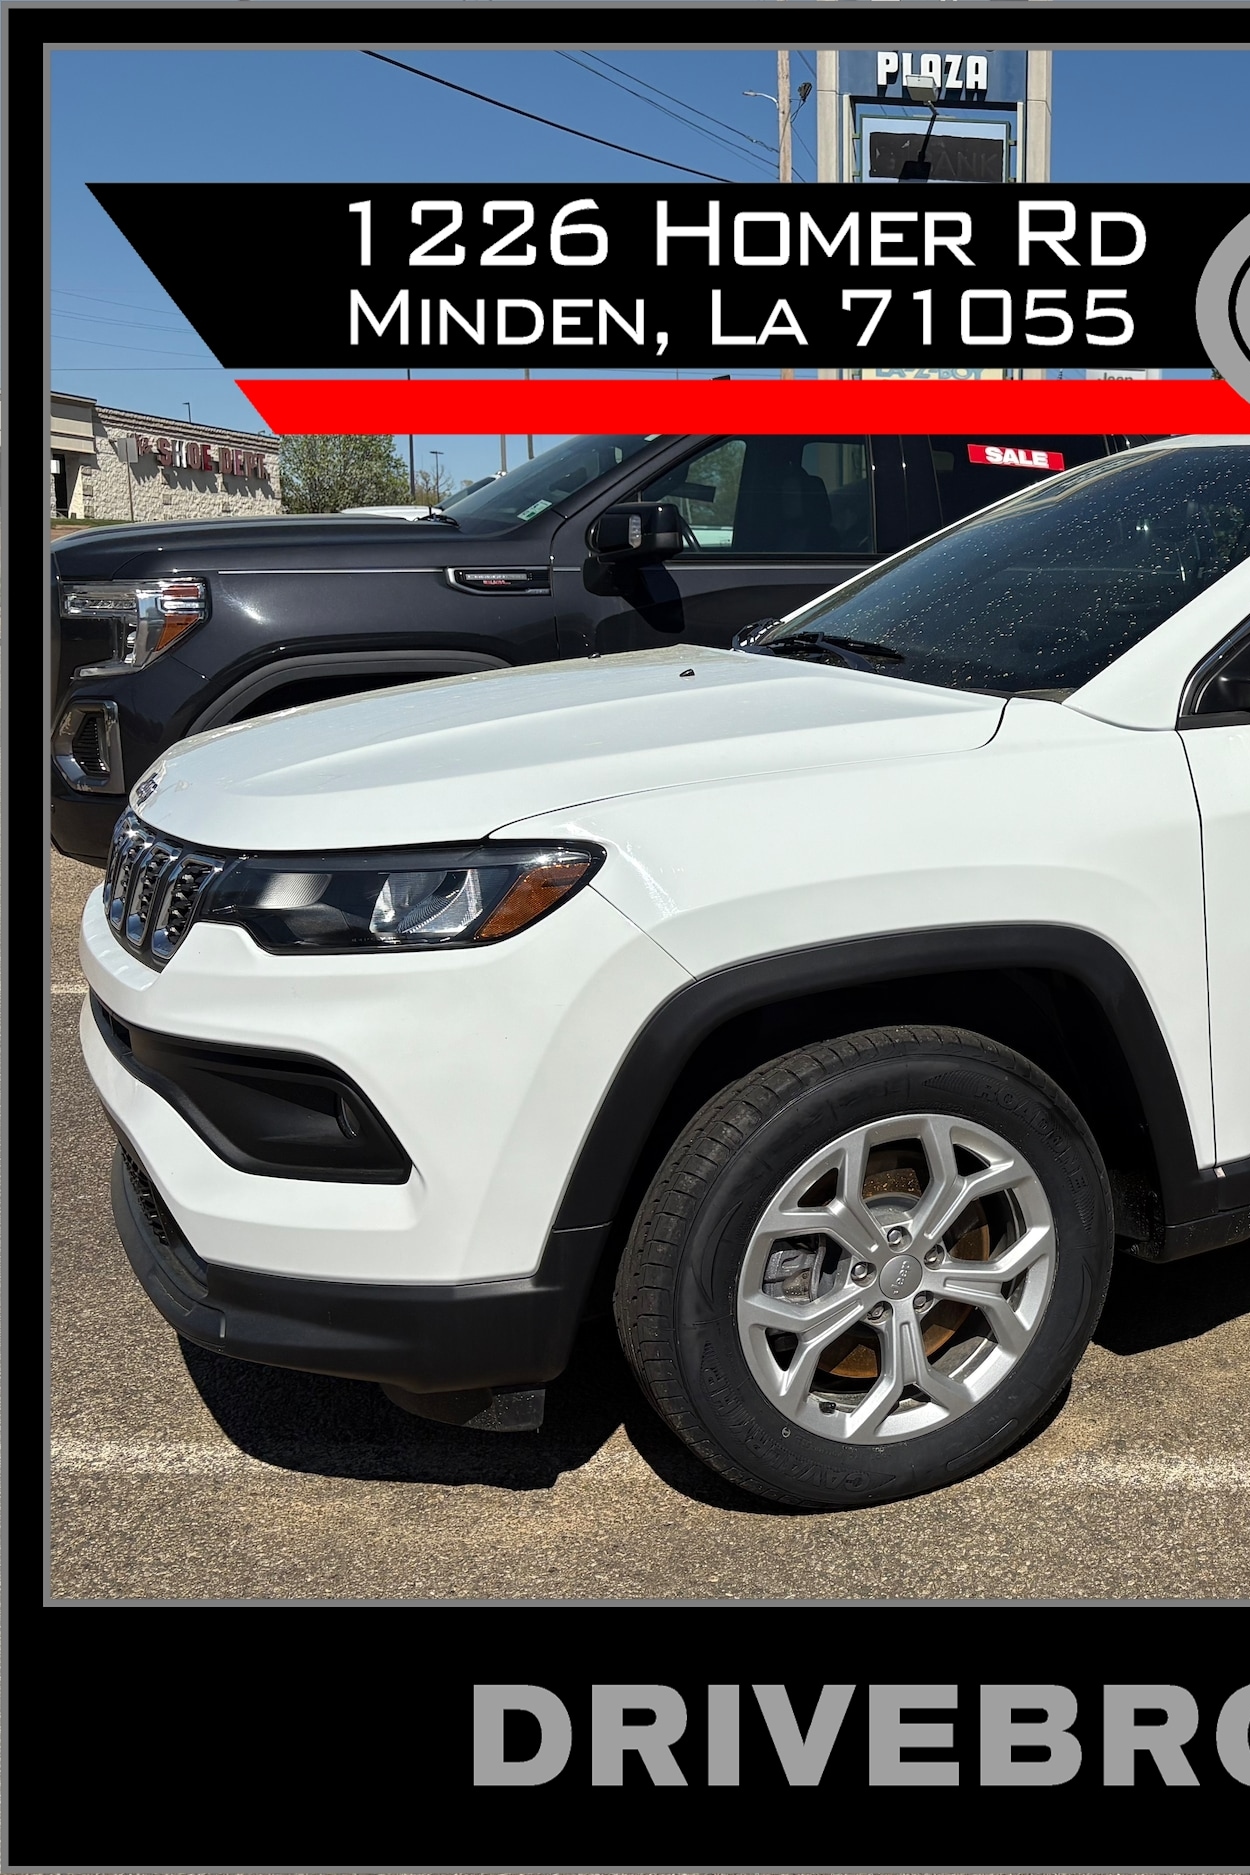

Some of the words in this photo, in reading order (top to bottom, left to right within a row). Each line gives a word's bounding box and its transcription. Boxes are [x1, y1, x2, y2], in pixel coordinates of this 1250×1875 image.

[877, 51, 988, 91] PLAZA
[157, 438, 212, 472] SHOE
[984, 446, 1050, 469] SALE
